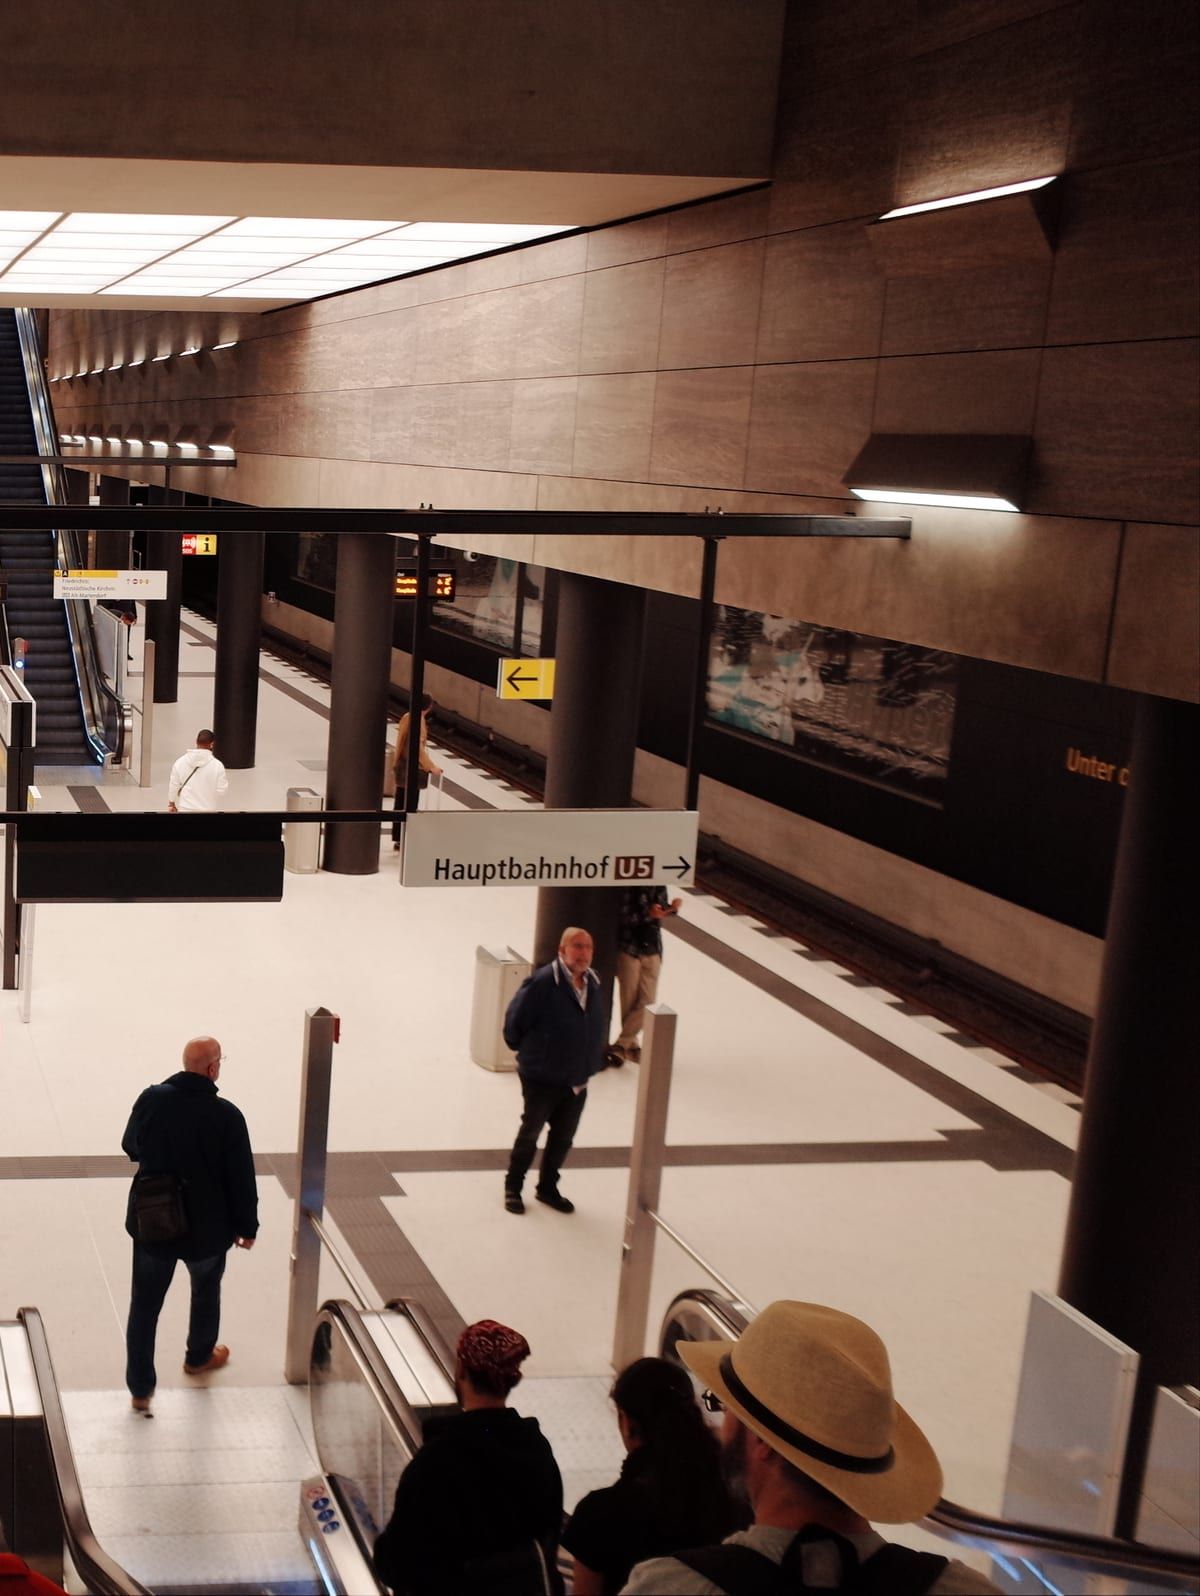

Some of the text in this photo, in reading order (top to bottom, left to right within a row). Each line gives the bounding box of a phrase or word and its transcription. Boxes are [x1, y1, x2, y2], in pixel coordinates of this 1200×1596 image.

[1067, 748, 1115, 781] Unter
[434, 856, 652, 886] Hauptbahnhof U5
